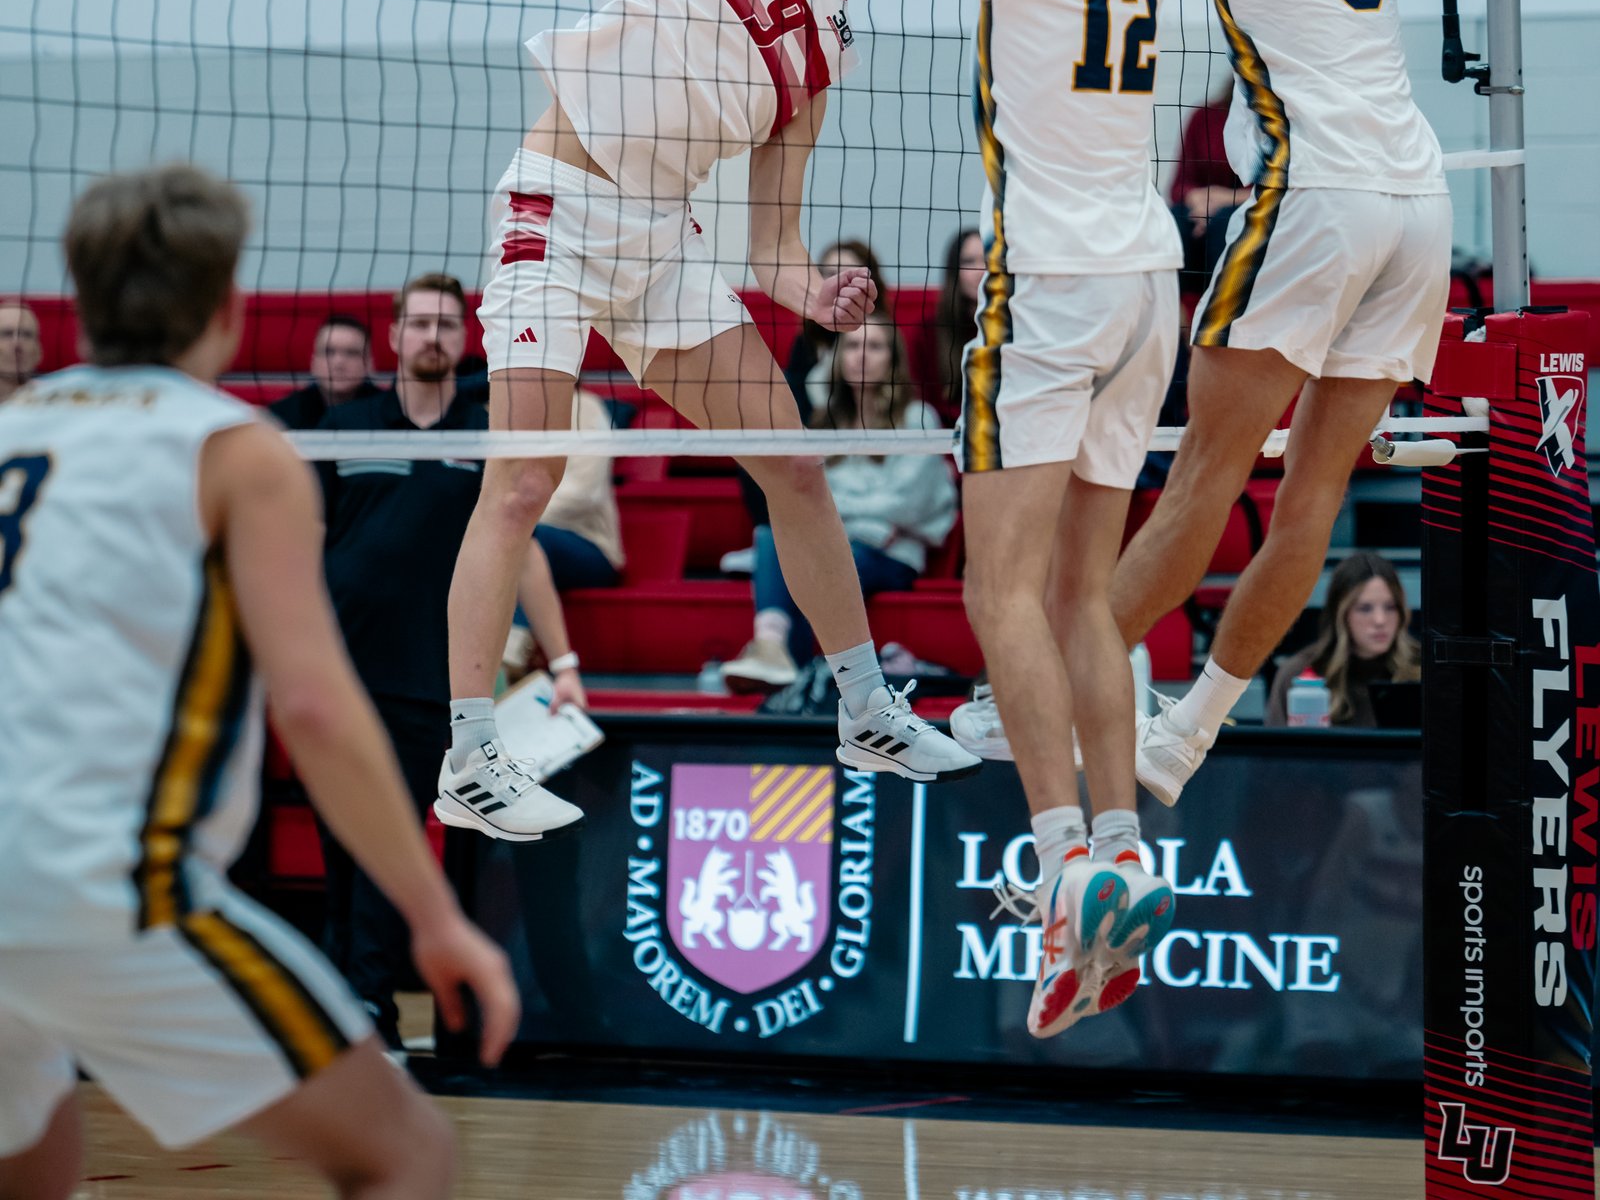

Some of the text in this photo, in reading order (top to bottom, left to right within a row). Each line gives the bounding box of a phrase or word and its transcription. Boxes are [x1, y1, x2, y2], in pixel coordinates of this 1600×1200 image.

[1540, 353, 1585, 373] LEWIS
[622, 759, 877, 1039] AD MAJOREM DEI GLORIAM
[673, 807, 751, 842] 1870
[1532, 594, 1570, 1007] FLYERS
[1570, 642, 1600, 952] LEWIS
[953, 922, 1342, 993] MECINE
[1458, 865, 1488, 1088] sports imports
